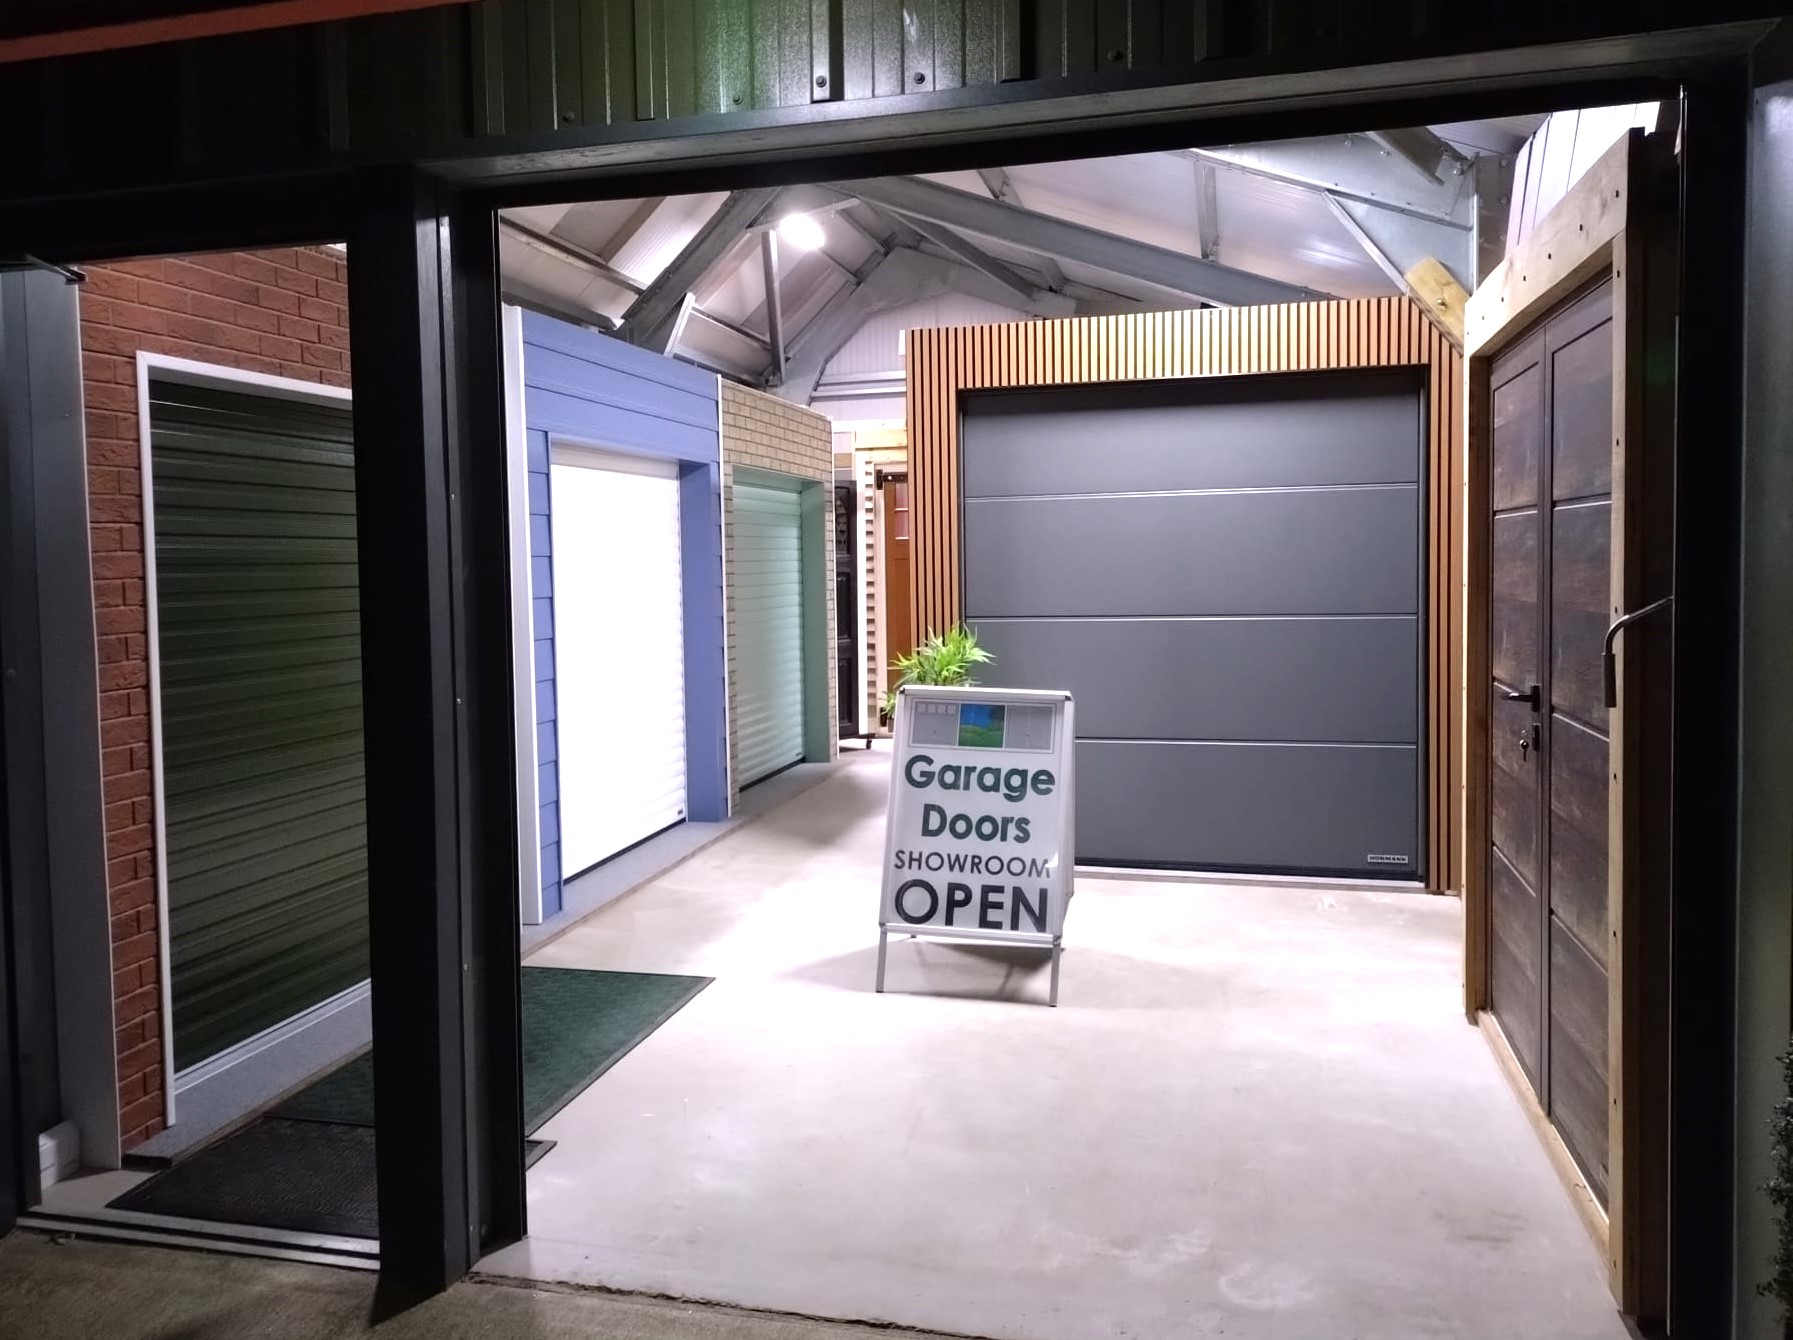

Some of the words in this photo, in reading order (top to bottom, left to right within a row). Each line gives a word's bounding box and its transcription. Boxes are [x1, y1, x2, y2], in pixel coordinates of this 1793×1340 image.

[905, 754, 1055, 802] Garage
[921, 803, 1031, 843] Doors
[894, 850, 1050, 878] SHOWROOM
[895, 879, 1048, 933] OPEN
